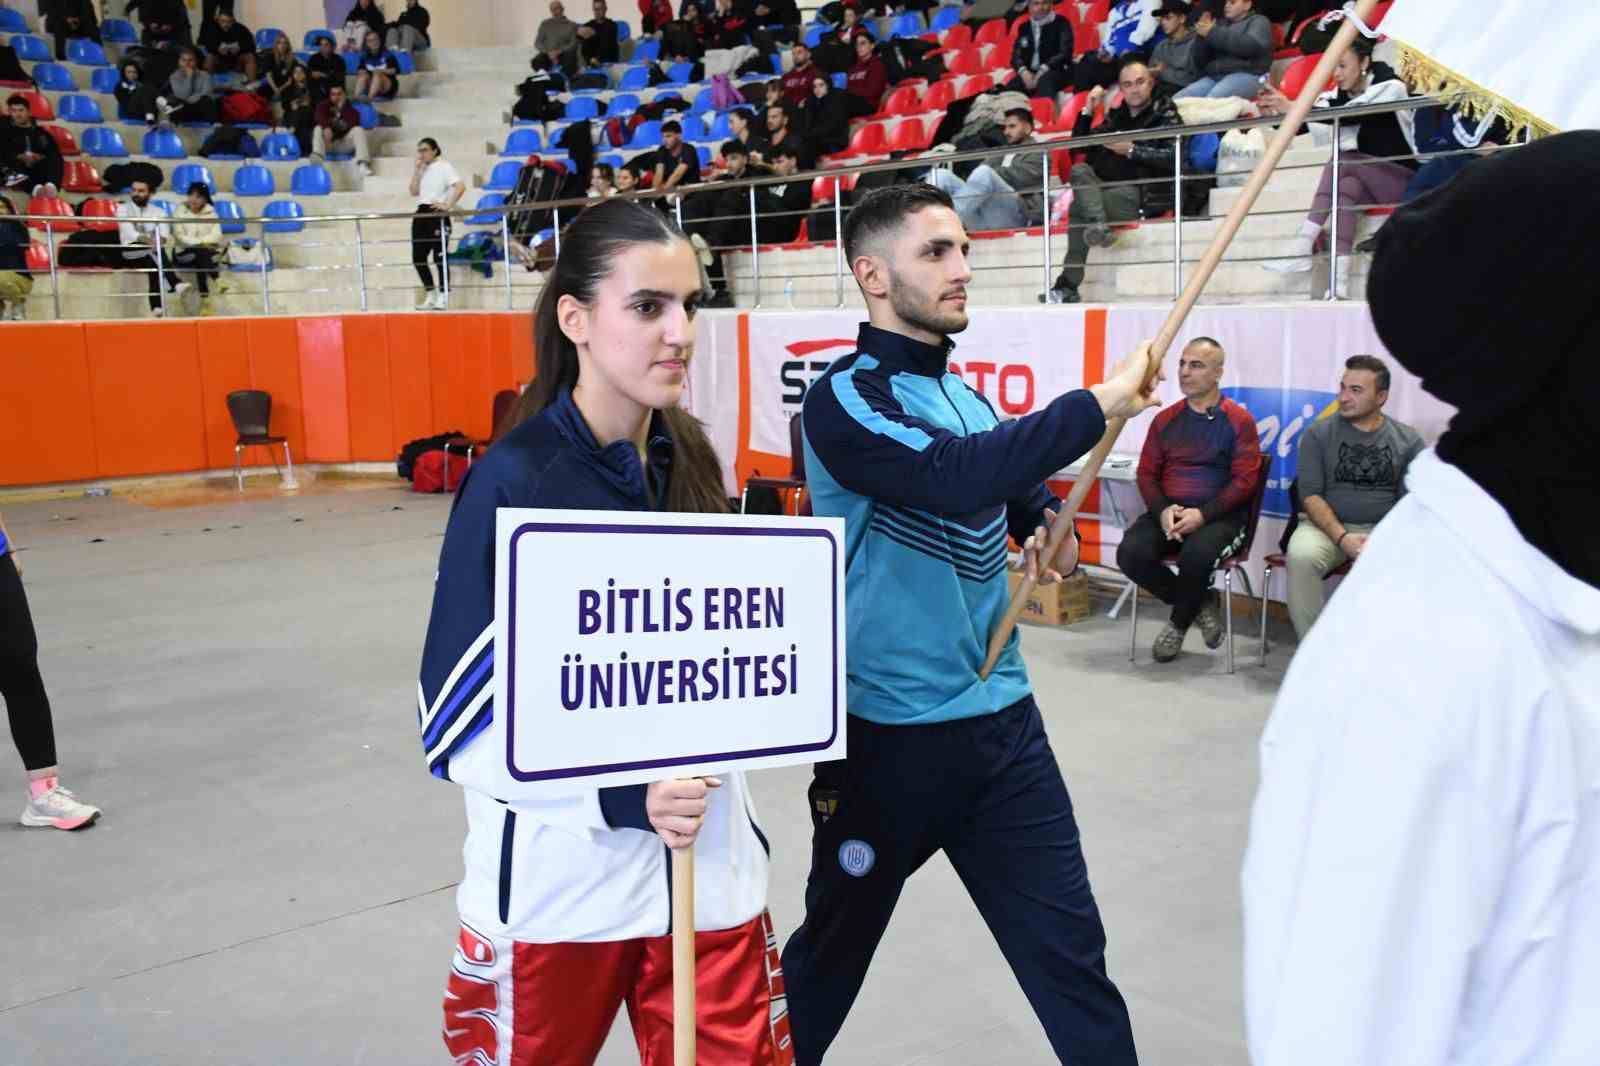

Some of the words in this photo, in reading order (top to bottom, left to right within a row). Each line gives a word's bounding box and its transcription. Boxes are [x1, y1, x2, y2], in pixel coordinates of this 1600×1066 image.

[578, 577, 693, 636] BİTLİS
[704, 586, 784, 631] EREN
[560, 643, 797, 711] ÜNİVERSİTESİ
